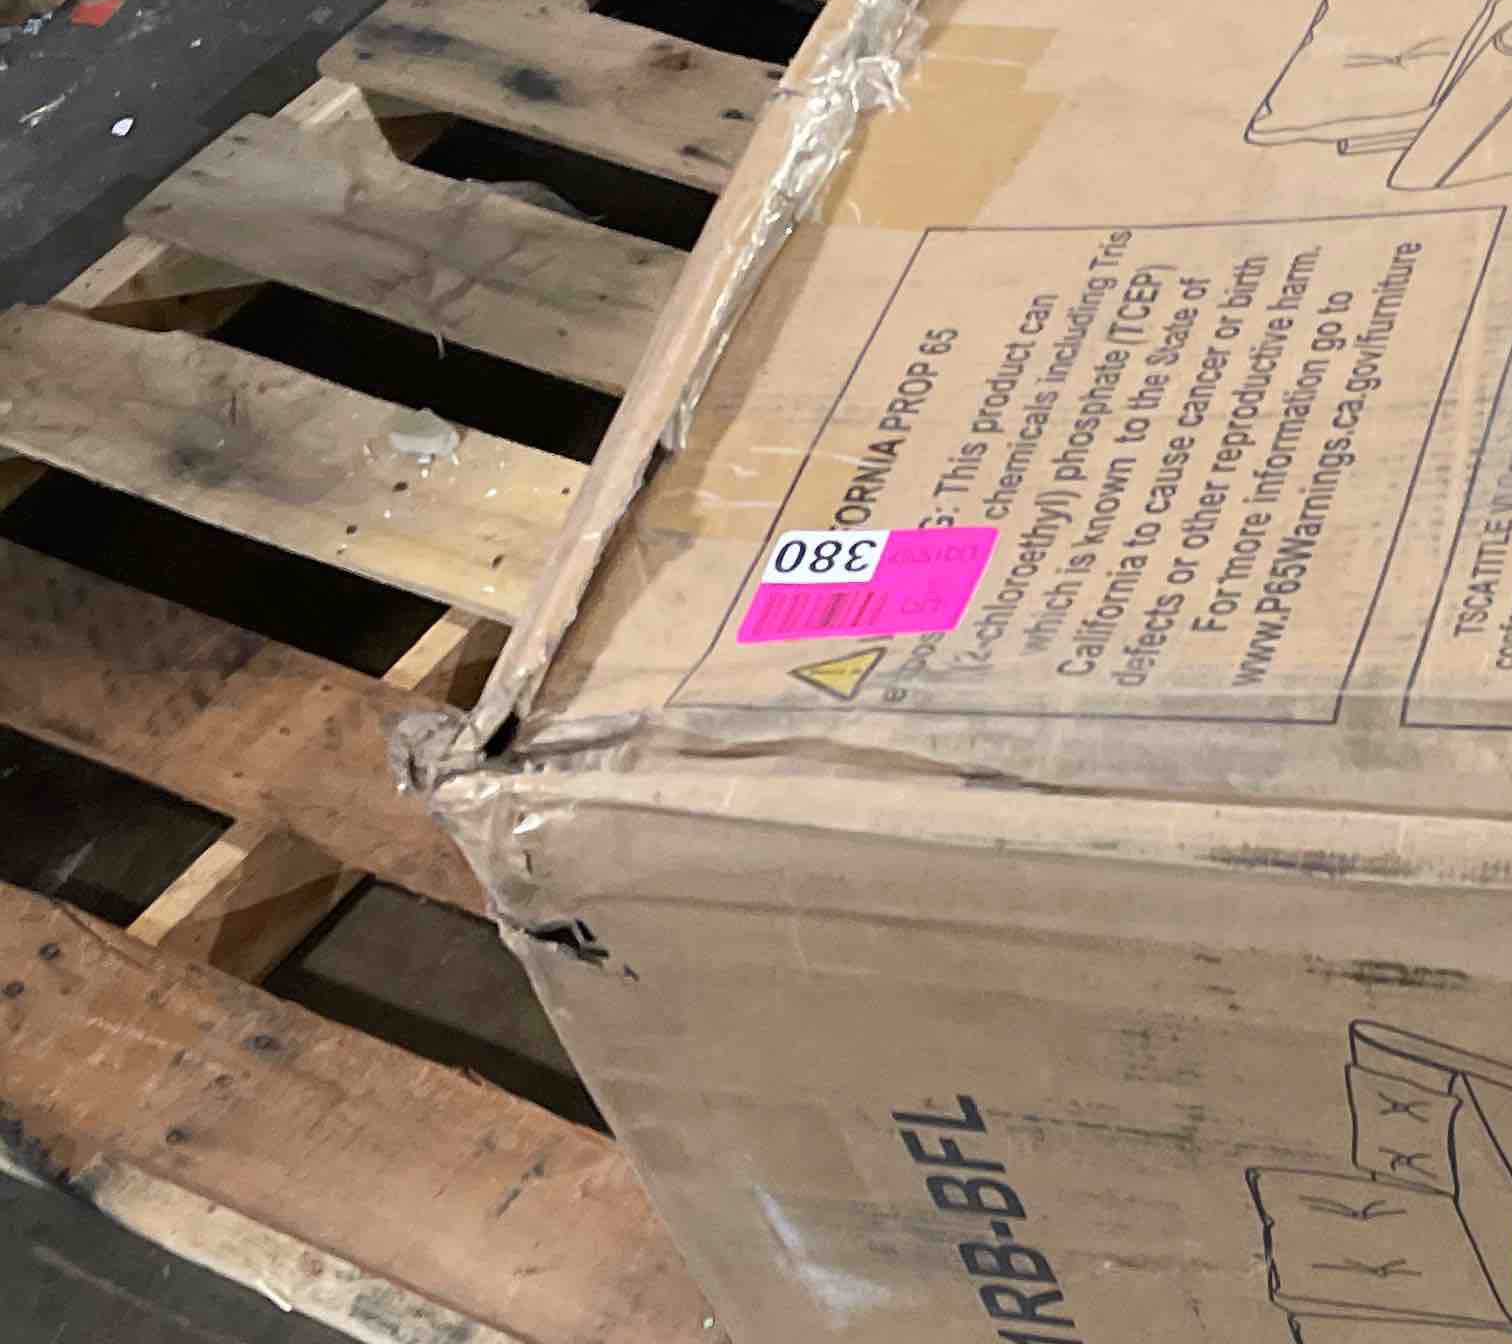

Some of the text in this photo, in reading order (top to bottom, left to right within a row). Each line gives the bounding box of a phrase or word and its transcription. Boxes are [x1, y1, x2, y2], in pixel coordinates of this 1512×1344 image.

[877, 363, 939, 430] PROP
[918, 328, 959, 354] 65
[932, 441, 989, 495] This
[971, 342, 1037, 433] product
[1018, 294, 1059, 334] can
[982, 391, 1059, 519] chemicals
[1035, 277, 1119, 383] including
[1088, 230, 1133, 269] Tris
[1023, 277, 1211, 655] which is known to the State of
[1051, 350, 1131, 480] phosphate
[1105, 264, 1177, 346] (TCEP)
[1057, 255, 1268, 677] California to cause cancer or birth
[1112, 245, 1321, 687] defects or other reproductive harm.
[1192, 290, 1354, 632] For more information go to
[1231, 242, 1422, 686] www.P65Warnings.ca.gov/furniture
[775, 540, 877, 573] 380
[1452, 579, 1499, 637] TSCA
